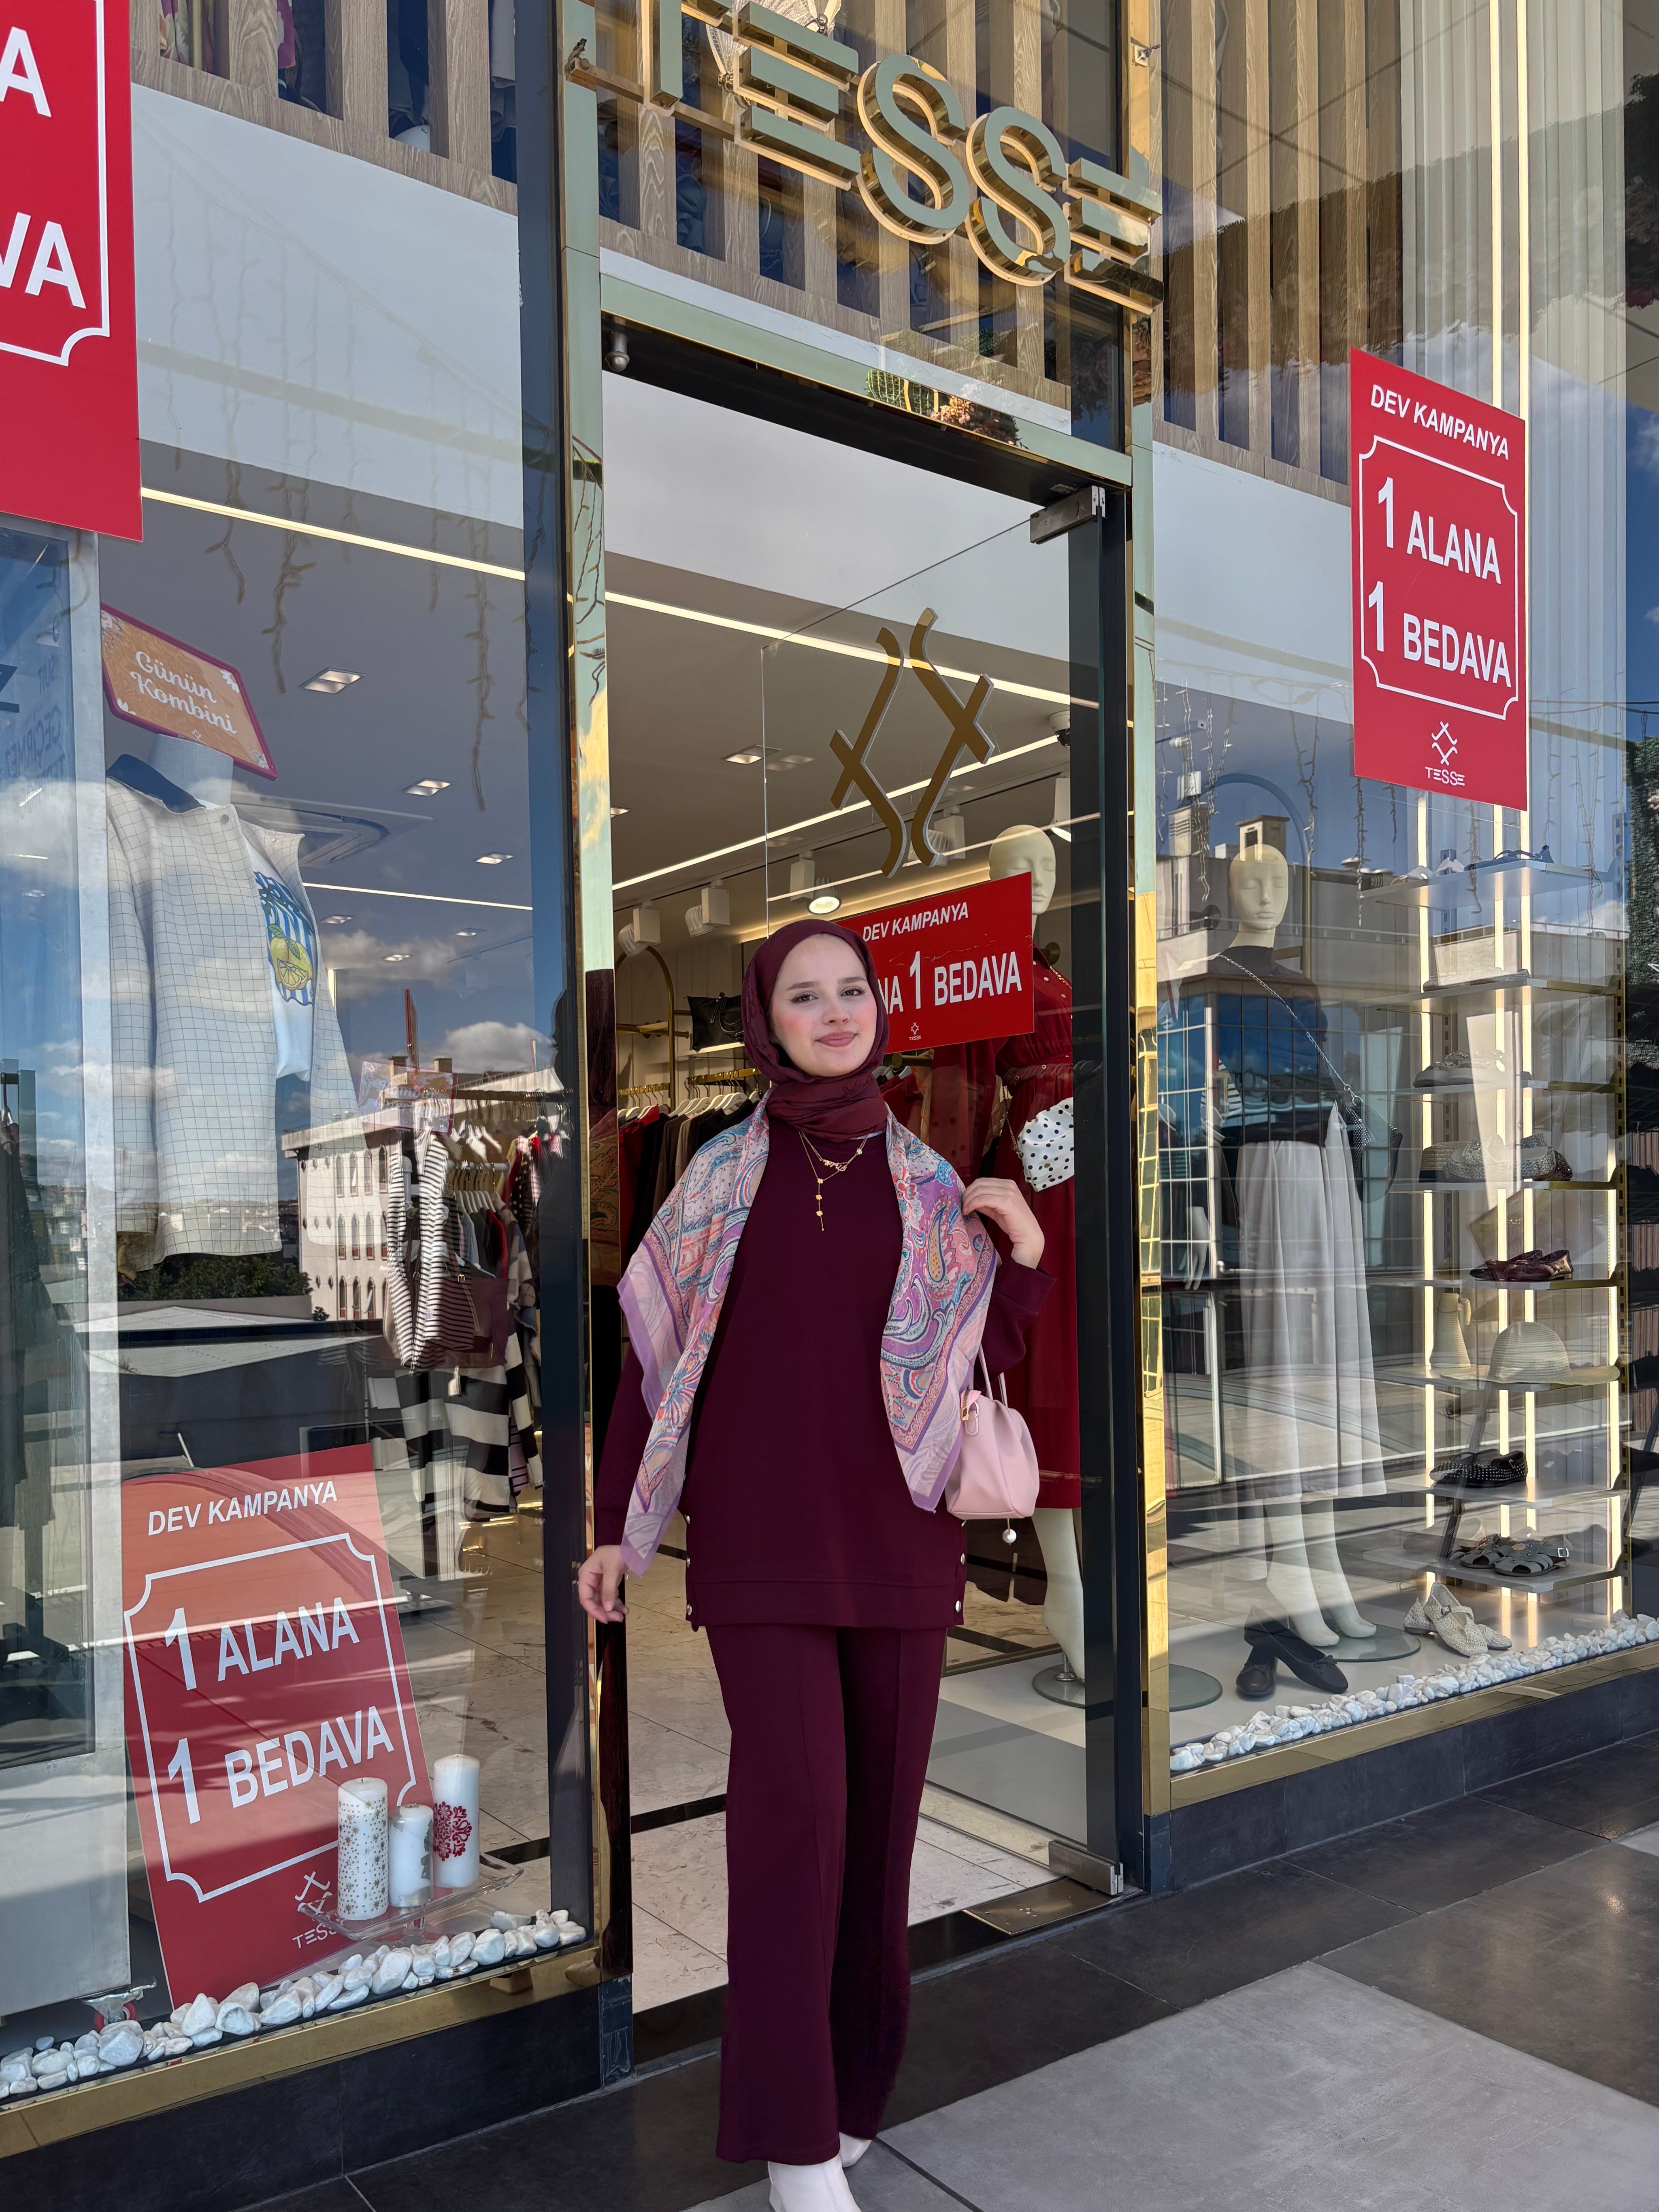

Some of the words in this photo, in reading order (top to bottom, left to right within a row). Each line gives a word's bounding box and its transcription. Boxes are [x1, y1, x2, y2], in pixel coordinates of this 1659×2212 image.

[641, 0, 1164, 315] TESSE
[1371, 384, 1410, 418] DEV
[1414, 402, 1509, 460] KAMPANYA
[1378, 477, 1394, 548] 1
[1407, 510, 1501, 584] ALANA
[1368, 581, 1384, 652] 1
[1403, 613, 1512, 687] BEDAVA
[130, 671, 237, 734] Kombini
[136, 651, 217, 704] Günün
[1425, 766, 1465, 786] TESSE
[863, 921, 890, 942] DEV
[892, 902, 969, 936] KAMPANYA
[910, 951, 921, 1009] 1
[935, 951, 1022, 1006] BEDAVA
[148, 1503, 202, 1536] DEV
[208, 1480, 337, 1524] KAMPANYA
[164, 1607, 197, 1691] 1
[217, 1597, 360, 1682] ALANA
[168, 1738, 200, 1824] 1
[225, 1706, 394, 1808] BEDAVA
[292, 1924, 337, 1948] TES
